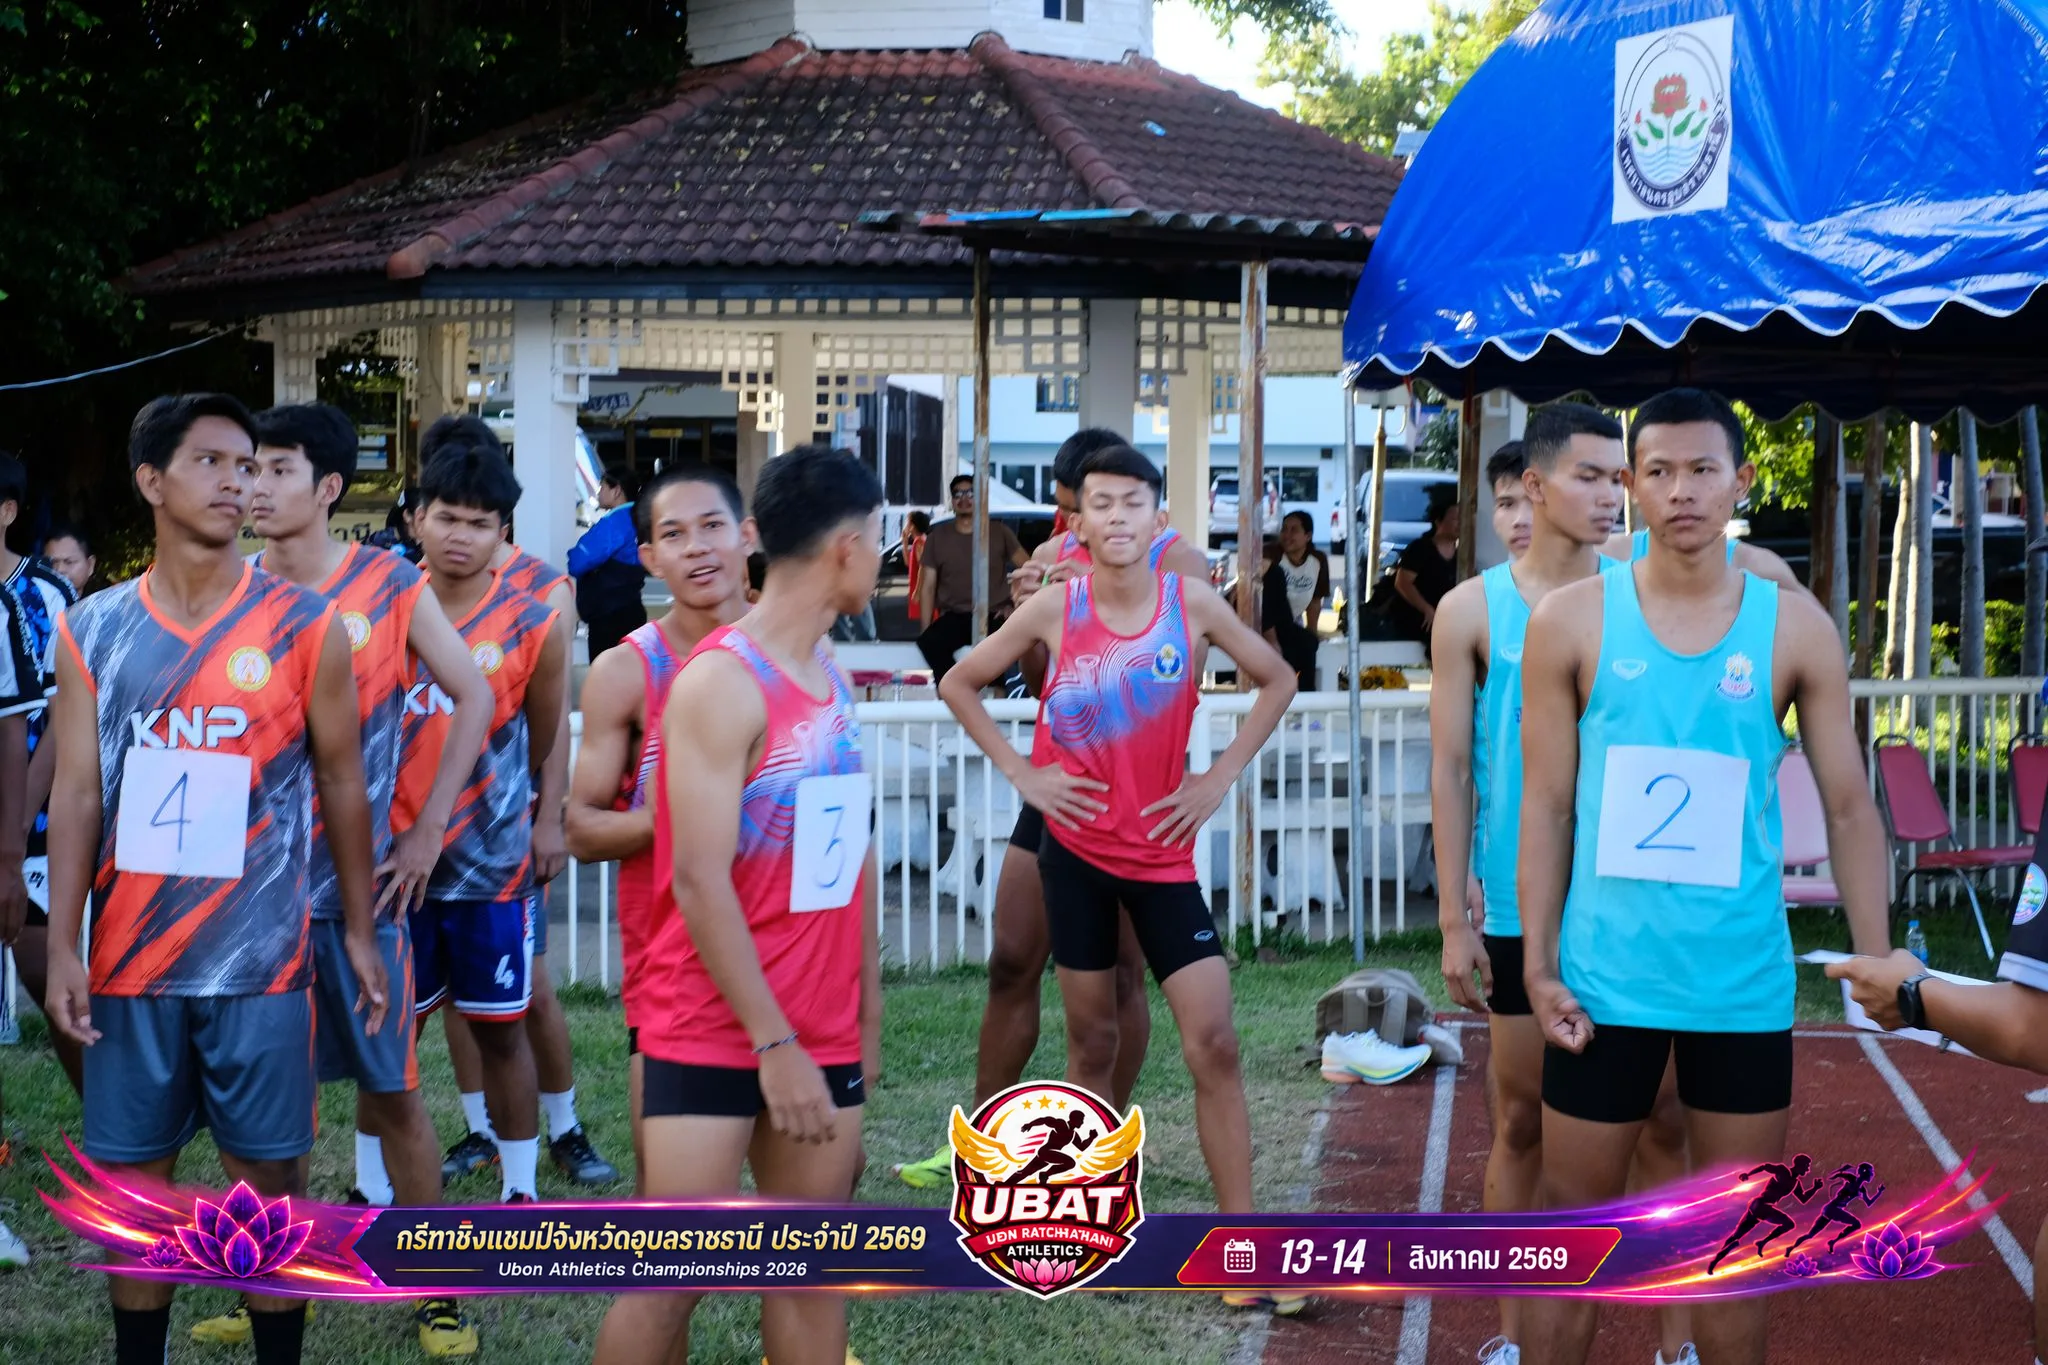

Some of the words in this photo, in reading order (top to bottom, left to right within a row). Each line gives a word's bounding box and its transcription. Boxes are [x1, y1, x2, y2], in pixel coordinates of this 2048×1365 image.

[131, 706, 249, 749] KNP
[150, 771, 191, 853] 4
[813, 805, 846, 889] 3
[1635, 774, 1696, 851] 2
[494, 954, 515, 989] 4
